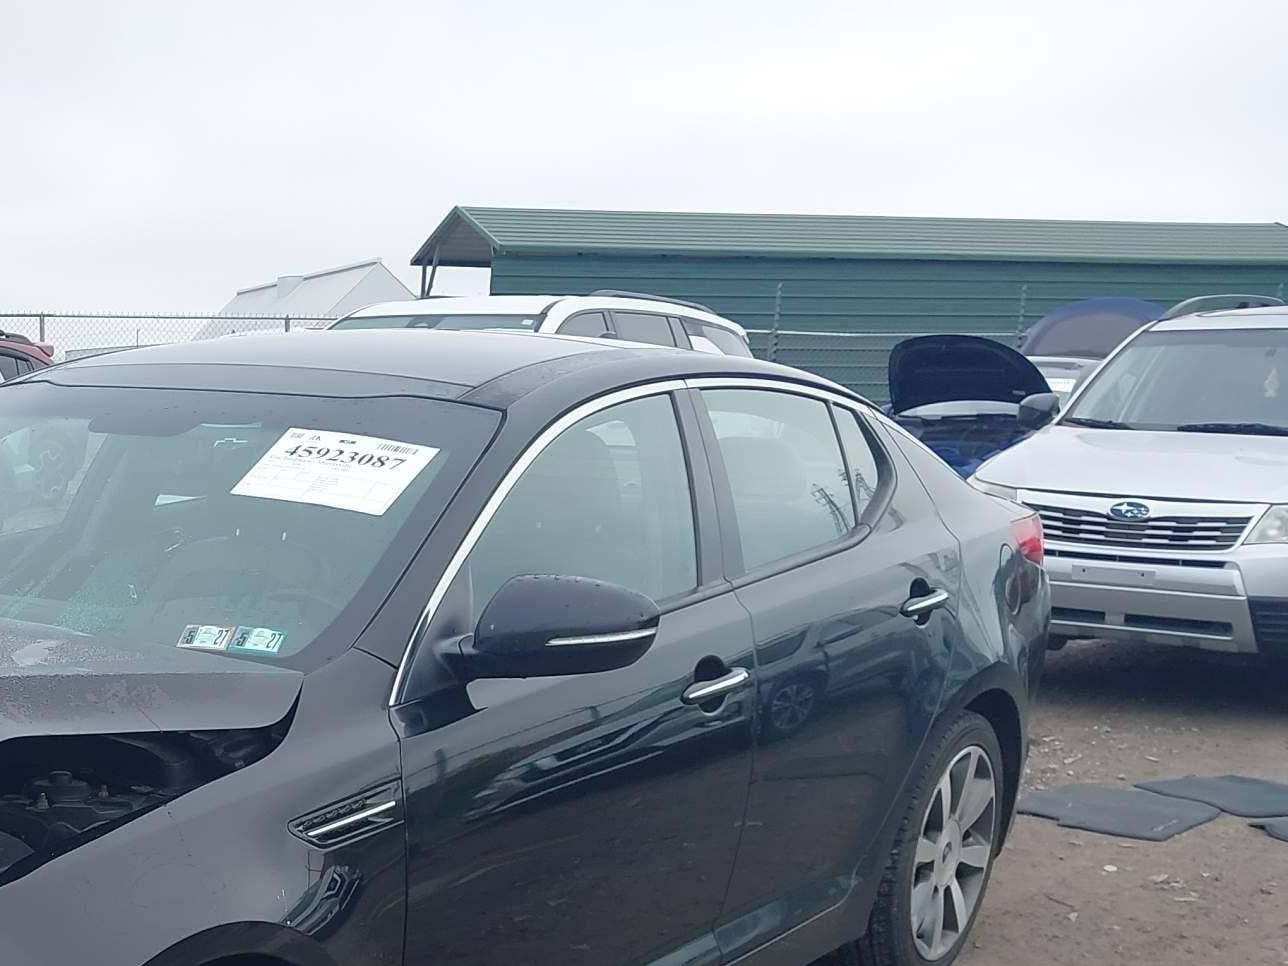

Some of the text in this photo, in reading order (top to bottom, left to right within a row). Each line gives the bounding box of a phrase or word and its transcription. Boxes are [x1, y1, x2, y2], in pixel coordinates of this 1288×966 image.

[285, 444, 407, 470] 45923087
[213, 629, 230, 647] 27
[266, 632, 282, 649] 27
